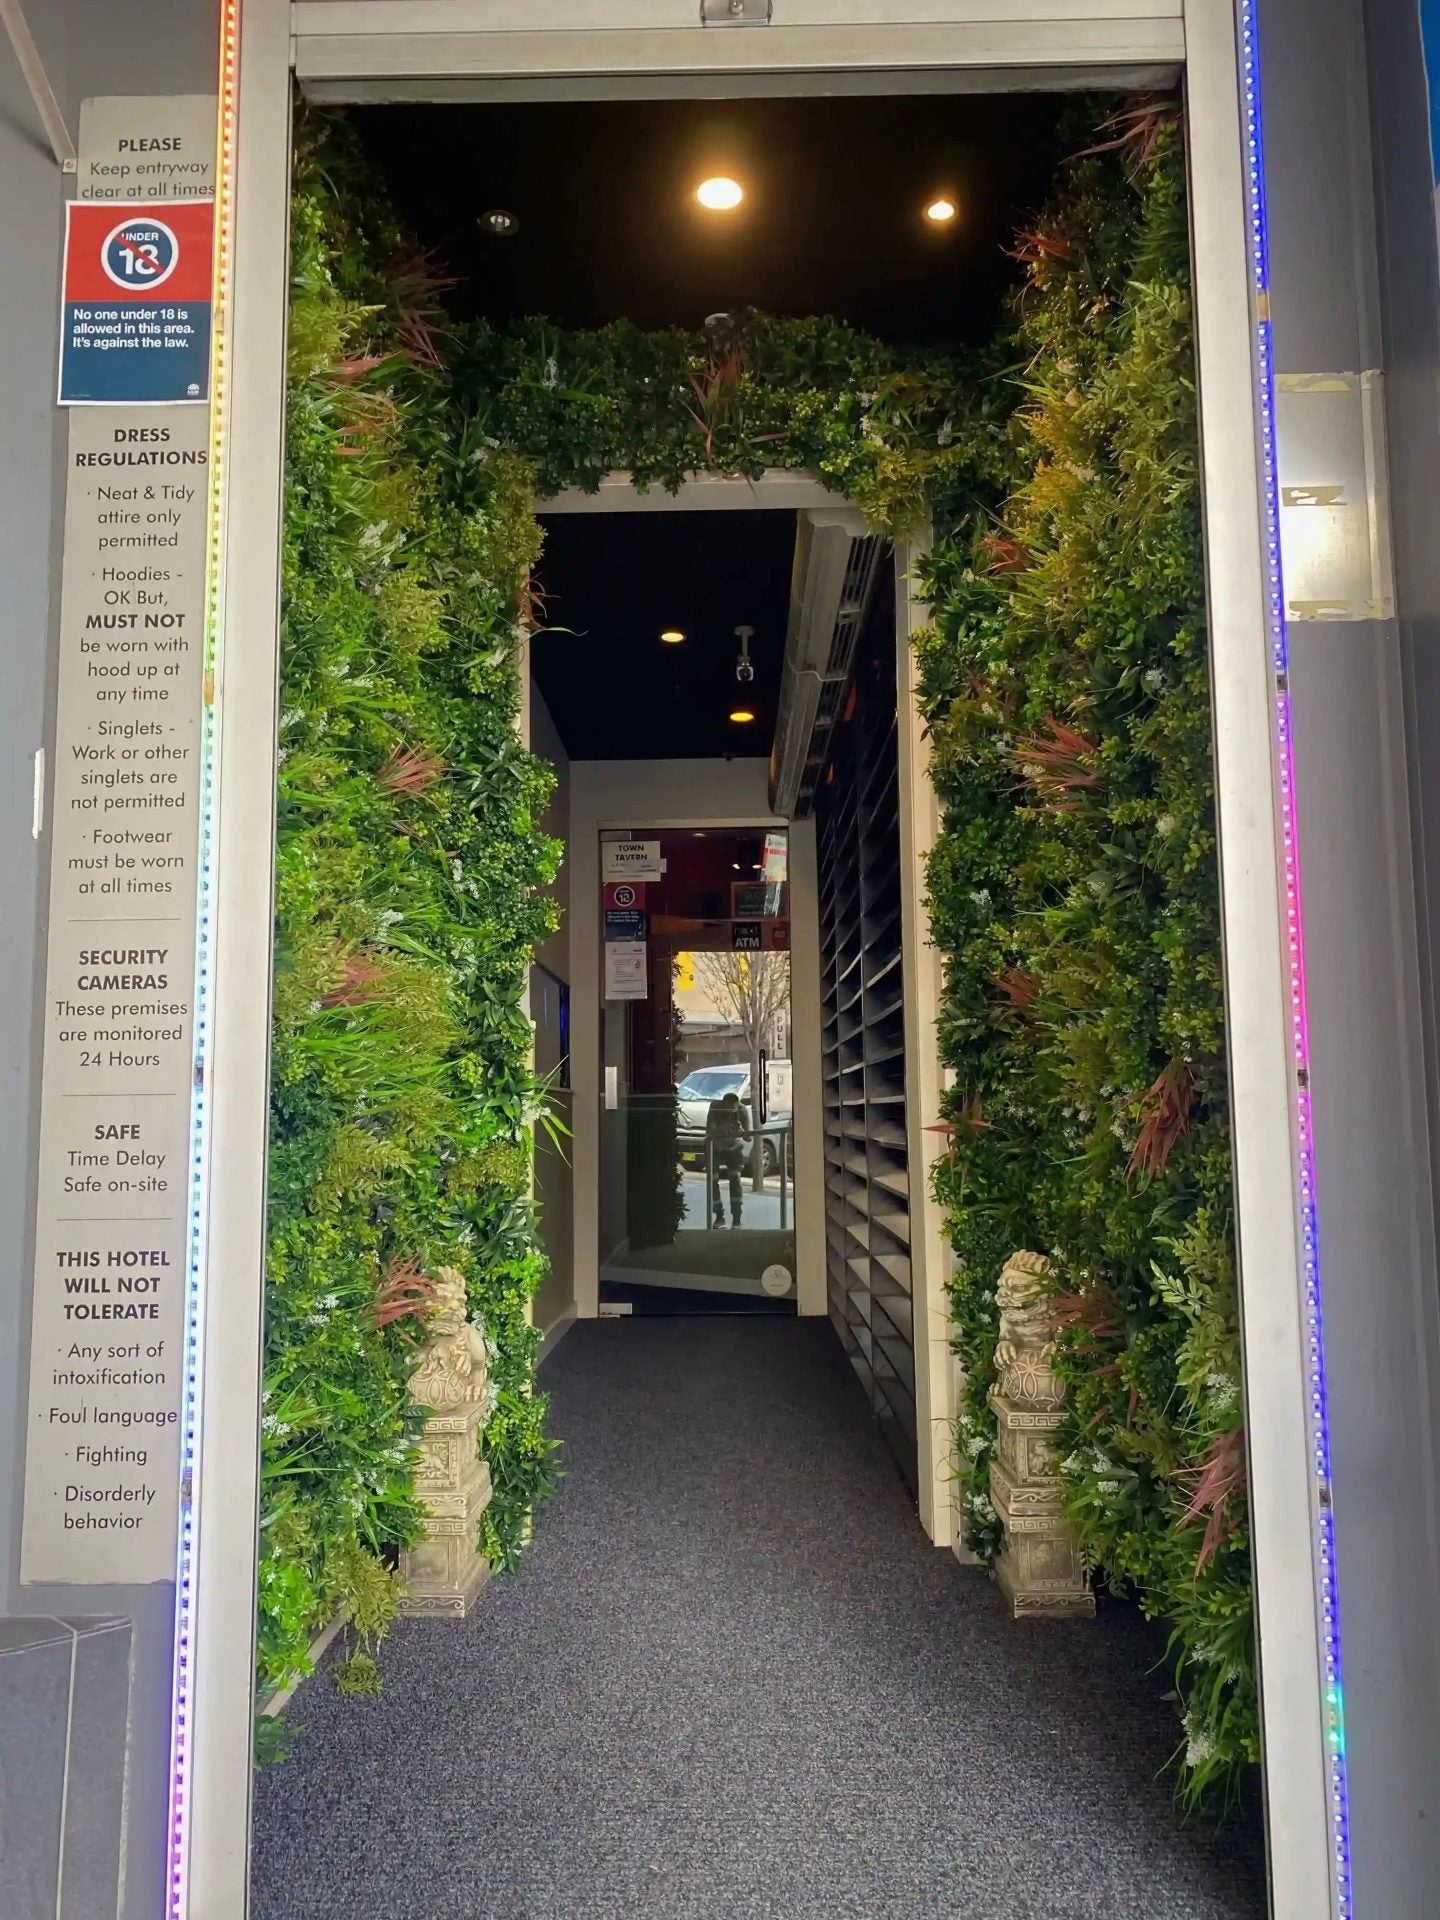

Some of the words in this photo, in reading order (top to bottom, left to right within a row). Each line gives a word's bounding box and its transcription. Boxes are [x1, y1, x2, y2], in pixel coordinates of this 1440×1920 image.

[118, 138, 182, 153] PLEASE
[90, 161, 130, 177] Keep
[136, 161, 209, 177] entryway
[82, 183, 122, 199] clear
[127, 184, 142, 197] at
[148, 183, 167, 196] all
[173, 182, 215, 196] times
[118, 244, 159, 275] 18
[74, 309, 92, 320] No
[95, 311, 118, 320] one
[121, 309, 157, 320] under
[160, 309, 175, 320] 18
[178, 308, 188, 320] is
[73, 323, 122, 335] allowed
[125, 323, 136, 334] in
[138, 323, 161, 334] this
[163, 325, 195, 335] area.
[73, 337, 91, 348] It's
[94, 337, 138, 350] against
[141, 337, 162, 348] the
[165, 337, 189, 348] law.
[114, 428, 170, 443] DRESS
[76, 451, 207, 467] REGULATIONS
[98, 486, 138, 500] Neat
[143, 486, 156, 500] &
[161, 485, 195, 504] Tidy
[98, 509, 140, 524] attire
[147, 508, 181, 526] only
[98, 532, 178, 551] permitted
[102, 566, 171, 581] Hoodies
[104, 591, 131, 605] OK
[138, 590, 168, 606] But,
[86, 614, 138, 629] MUST
[145, 614, 186, 628] NOT
[81, 638, 100, 652] be
[106, 641, 148, 652] worn
[154, 636, 189, 651] with
[88, 661, 130, 677] hood
[137, 665, 158, 679] up
[163, 663, 180, 676] at
[97, 690, 127, 704] any
[132, 686, 169, 701] time
[98, 720, 163, 739] Singlets
[72, 744, 116, 760] Work
[121, 748, 140, 759] or
[144, 744, 190, 760] other
[81, 769, 144, 788] singlets
[149, 772, 178, 784] are
[71, 796, 98, 810] not
[104, 792, 185, 812] permitted
[93, 829, 173, 845] Footwear
[618, 844, 645, 852] TOWN
[68, 855, 109, 869] must
[115, 853, 136, 868] be
[141, 856, 184, 868] worn
[615, 854, 648, 862] TAVERN
[79, 879, 95, 894] at
[100, 878, 121, 893] all
[126, 878, 173, 893] times
[735, 937, 760, 948] ATM
[78, 949, 169, 966] SECURITY
[77, 974, 168, 990] CAMERAS
[55, 1001, 105, 1016] These
[111, 1000, 188, 1019] premises
[59, 1030, 87, 1042] are
[93, 1024, 183, 1041] monitored
[79, 1051, 103, 1067] 24
[109, 1051, 160, 1067] Hours
[94, 1124, 141, 1140] SAFE
[67, 1151, 110, 1166] Time
[116, 1150, 167, 1169] Delay
[64, 1176, 102, 1192] Safe
[107, 1176, 168, 1192] on-site
[56, 1251, 101, 1268] THIS
[107, 1250, 171, 1267] HOTEL
[64, 1278, 111, 1294] WILL
[117, 1277, 161, 1293] NOT
[63, 1304, 160, 1320] TOLERATE
[67, 1343, 102, 1362] Any
[107, 1343, 140, 1358] sort
[146, 1341, 165, 1358] of
[53, 1368, 166, 1385] intoxification
[49, 1407, 87, 1424] Foul
[93, 1406, 178, 1427] language
[75, 1446, 148, 1466] Fighting
[65, 1484, 157, 1505] Disorderly
[63, 1512, 143, 1529] behavior
